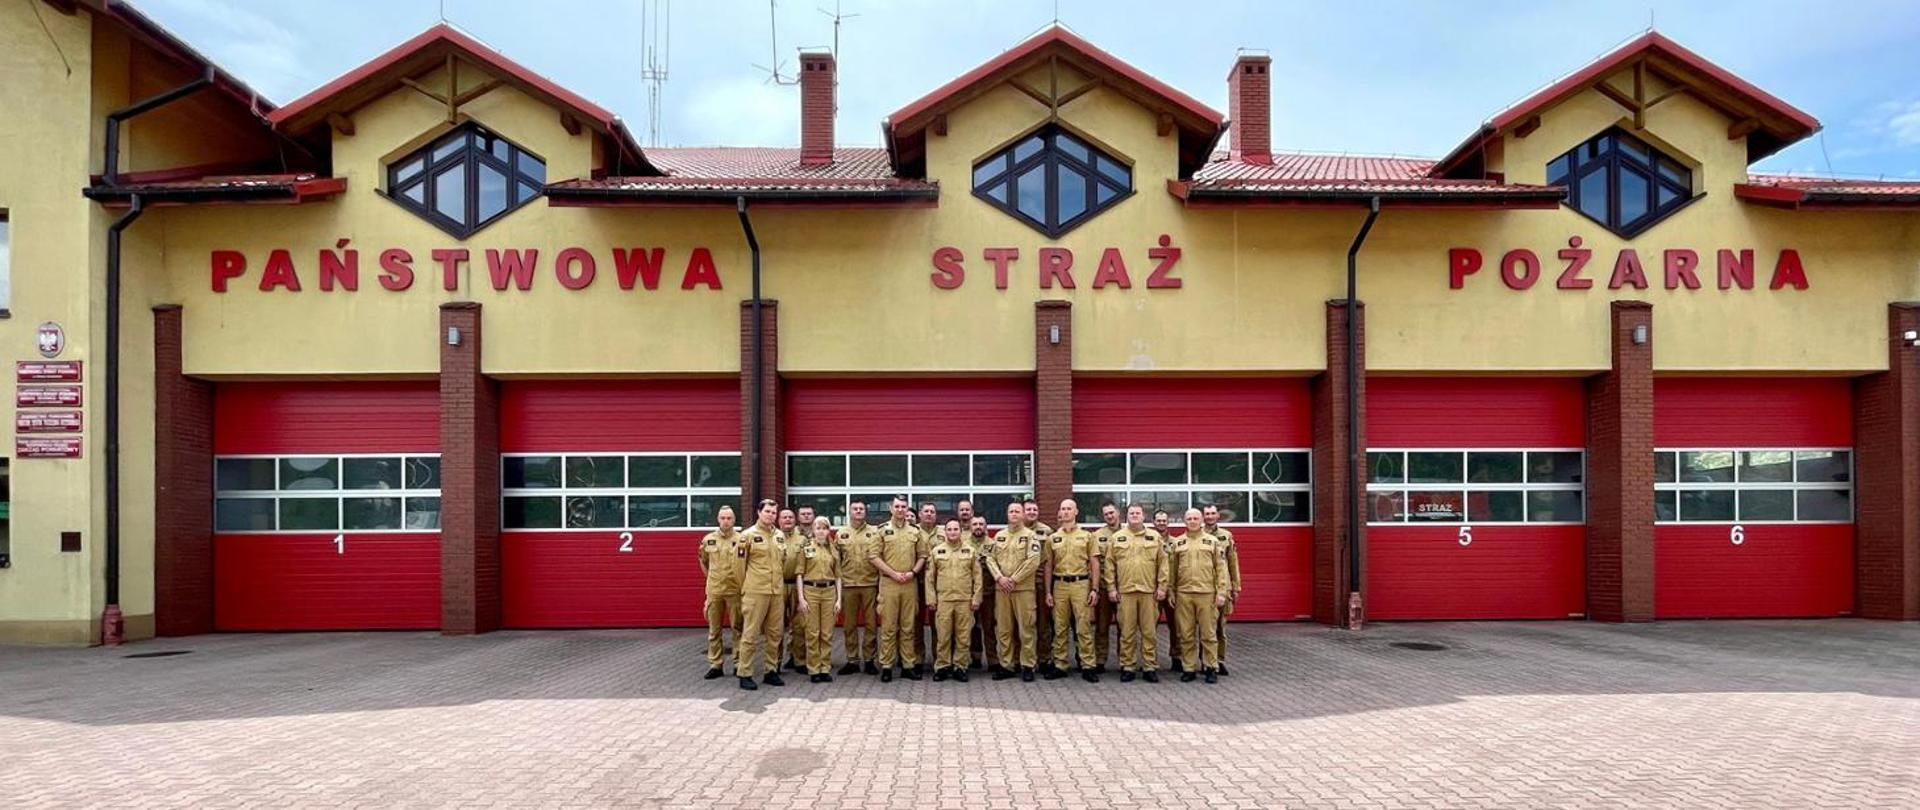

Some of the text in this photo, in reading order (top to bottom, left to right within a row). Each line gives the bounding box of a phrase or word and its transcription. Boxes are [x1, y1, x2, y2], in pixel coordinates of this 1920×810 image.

[211, 234, 1809, 293] PAŃSTWOWA STRAŻ POŻARNA
[334, 534, 344, 554] 1
[619, 532, 633, 552] 2
[1458, 526, 1472, 546] 5
[1730, 525, 1744, 545] 6
